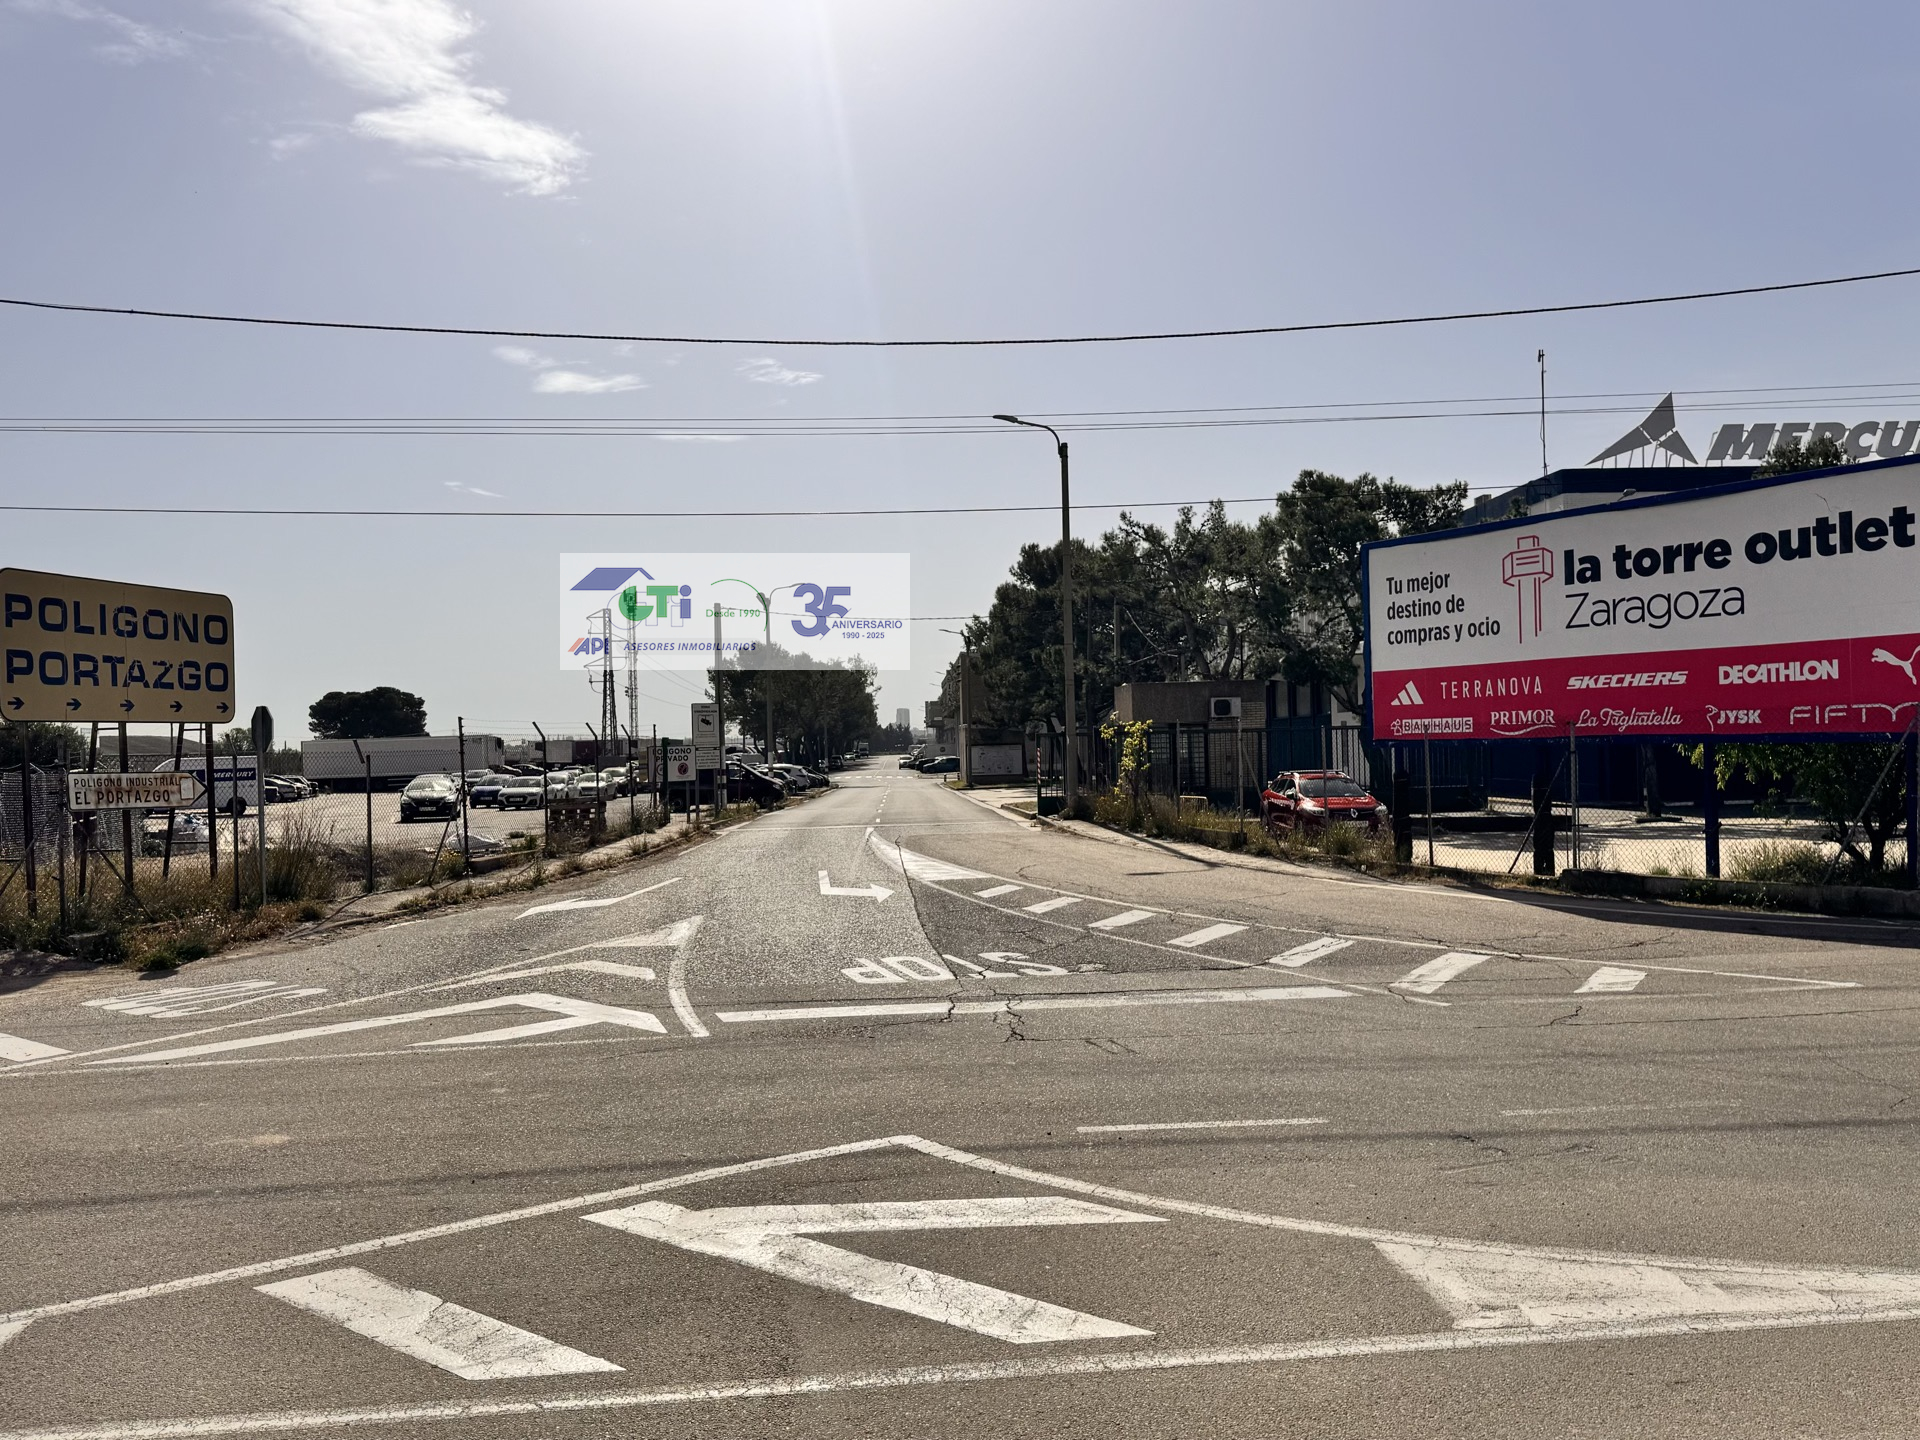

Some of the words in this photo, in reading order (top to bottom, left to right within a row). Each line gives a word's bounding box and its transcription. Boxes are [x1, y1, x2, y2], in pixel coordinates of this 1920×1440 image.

[1707, 421, 1920, 460] MERCU
[1564, 549, 1601, 586] la
[1613, 538, 1732, 580] torre
[1744, 506, 1915, 565] outlet
[1386, 577, 1403, 596] Tu
[1407, 572, 1450, 595] mejor
[4, 593, 228, 645] POLIGONO
[1387, 600, 1441, 620] destino
[1446, 594, 1465, 613] de
[1565, 586, 1745, 629] Zaragoza
[1387, 624, 1450, 646] compras
[1454, 623, 1463, 642] y
[1467, 616, 1500, 637] ocio
[6, 649, 229, 692] PORTAZGO
[1566, 671, 1689, 690] SKECHERS
[1718, 659, 1839, 685] DECATHLON
[1440, 676, 1542, 700] TERRANOVA
[1402, 717, 1473, 733] BAUHAUS
[1490, 709, 1556, 726] PRIMOR
[1575, 709, 1599, 727] La
[1600, 706, 1683, 732] Tagliatella
[1717, 709, 1762, 724] JYSK
[1790, 701, 1918, 725] FIFTY
[73, 778, 121, 788] POLIGONO
[125, 776, 180, 786] INDUSTRIAL
[74, 791, 91, 805] EL
[96, 789, 171, 804] PORTAZGO
[841, 952, 1070, 984] STOP
